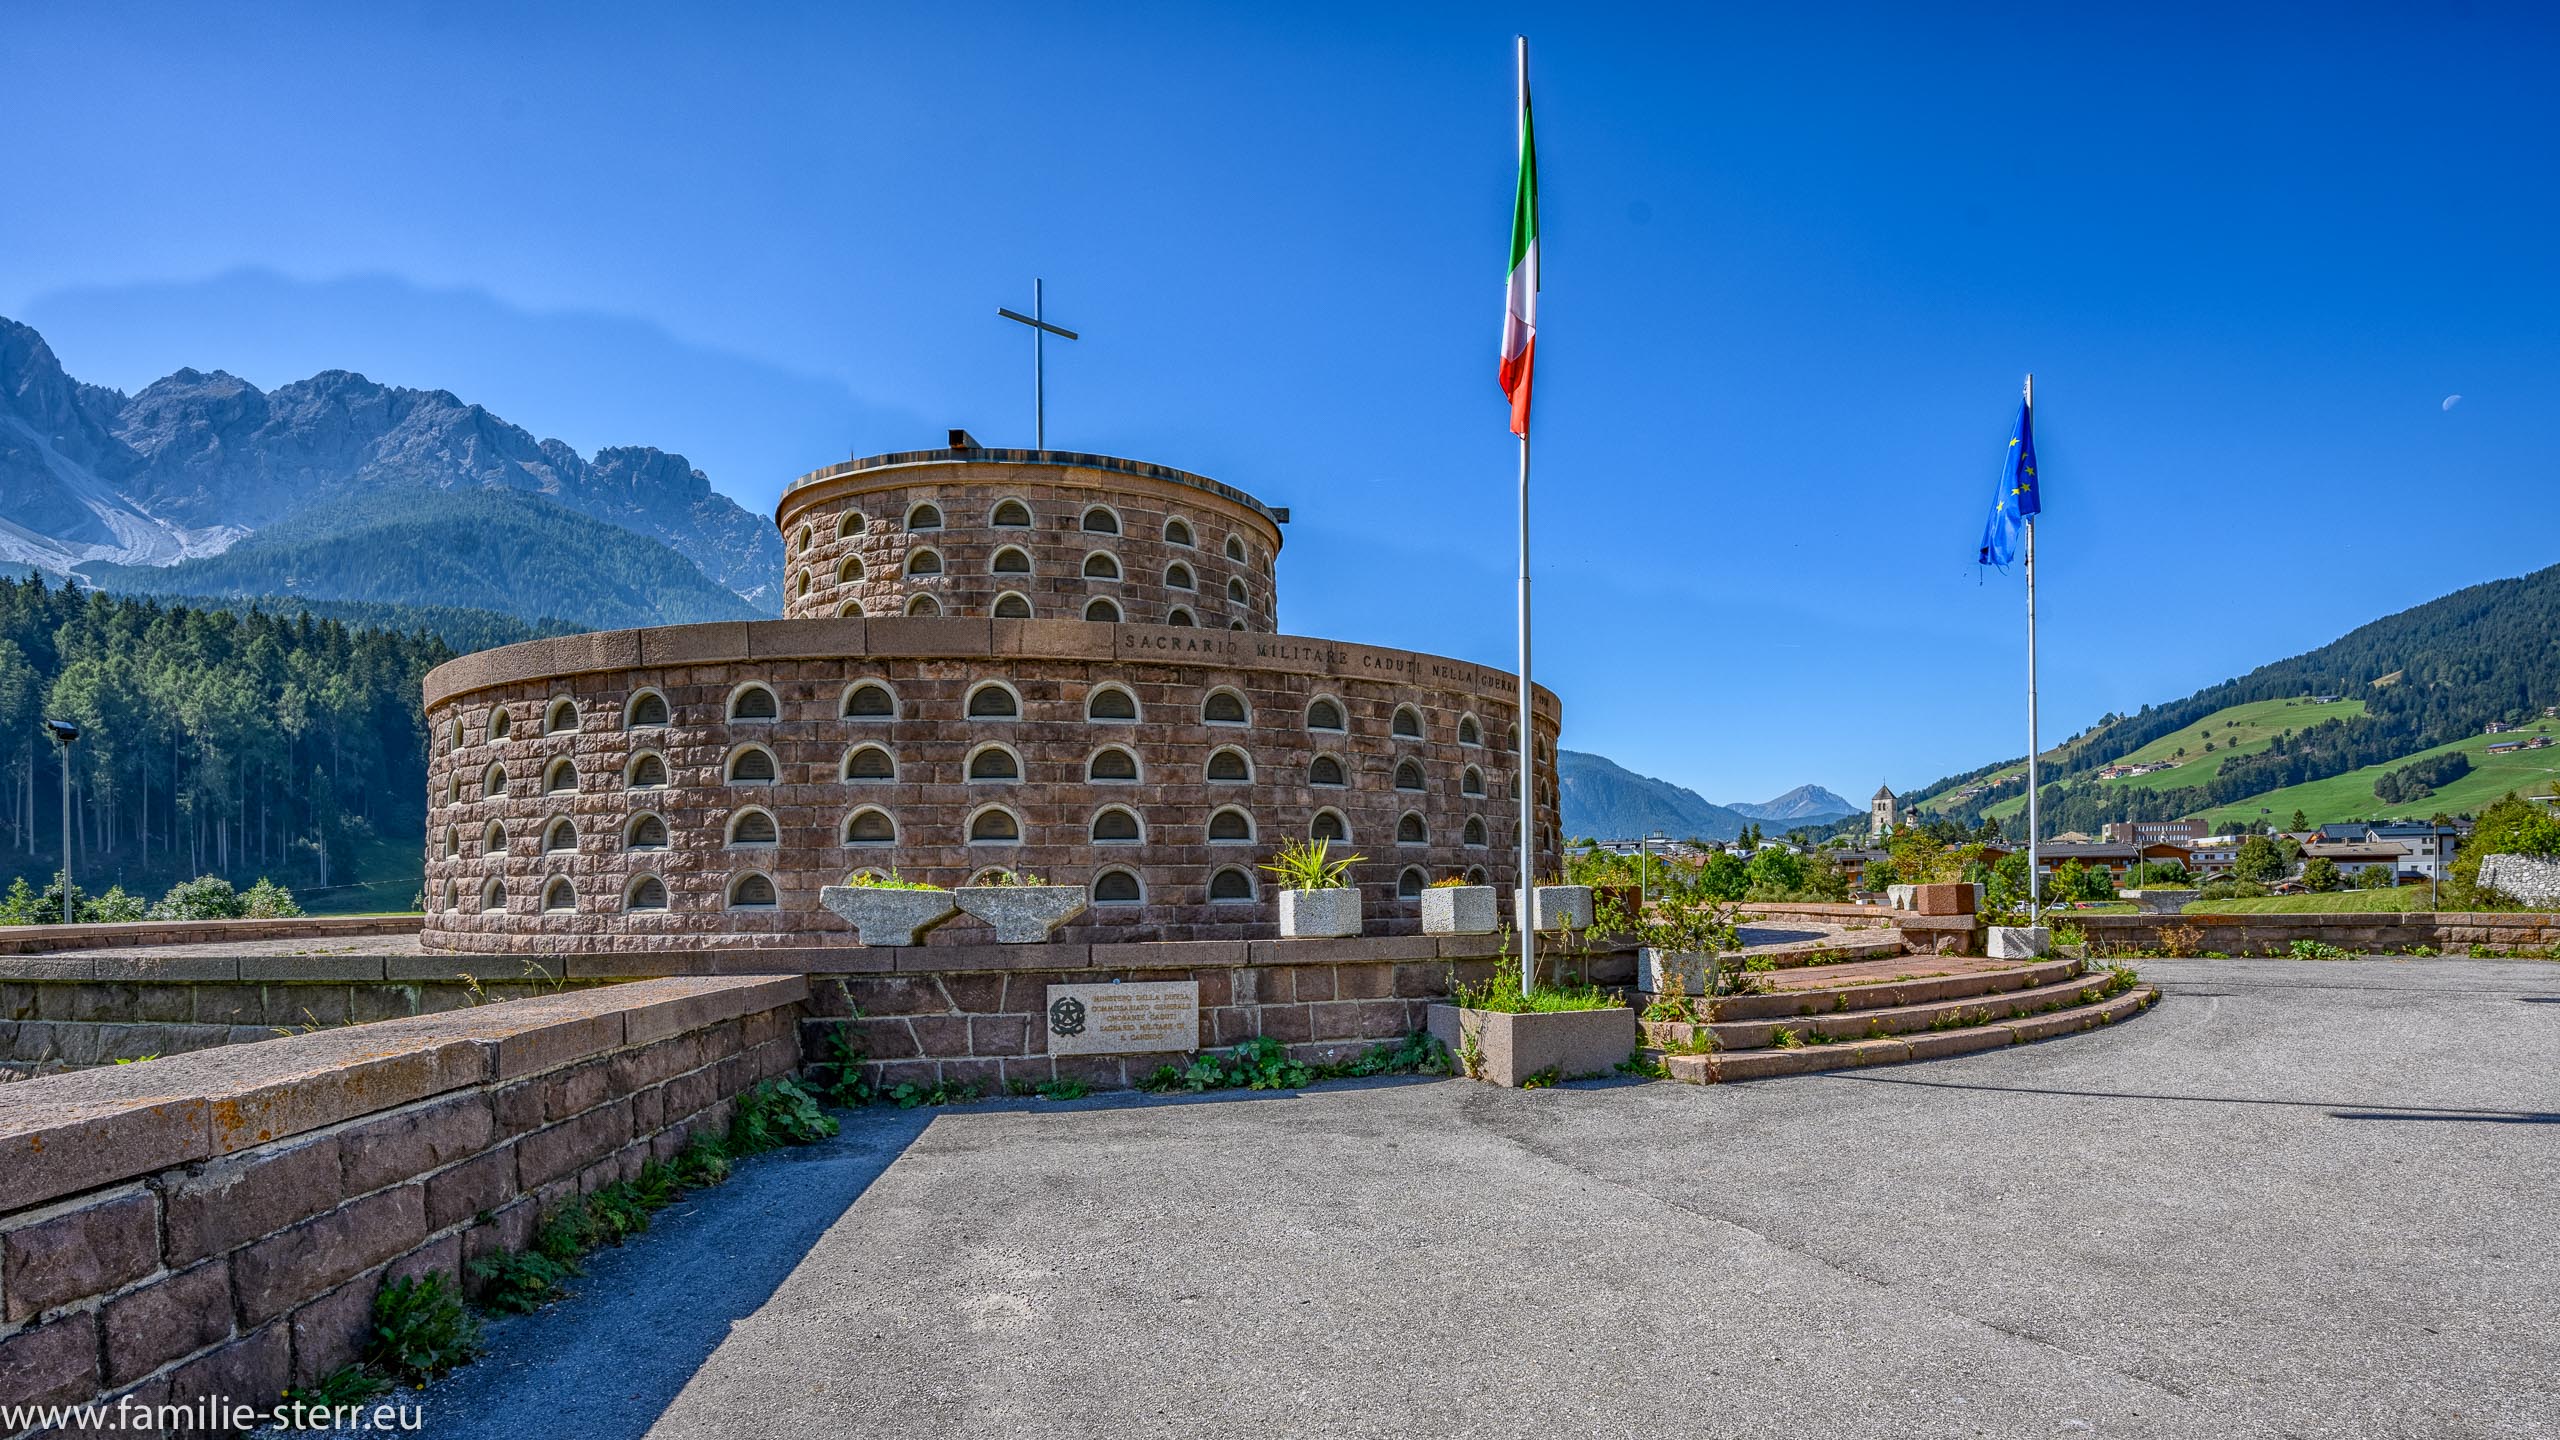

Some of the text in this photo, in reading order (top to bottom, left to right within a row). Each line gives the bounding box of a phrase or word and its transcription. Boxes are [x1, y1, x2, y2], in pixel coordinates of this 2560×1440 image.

[1125, 634, 1237, 655] SACRARIO
[1256, 644, 1348, 665] MILITARE
[1363, 655, 1422, 675] CADUTI
[1432, 664, 1472, 683] NELLA
[1481, 675, 1517, 694] GUERRA
